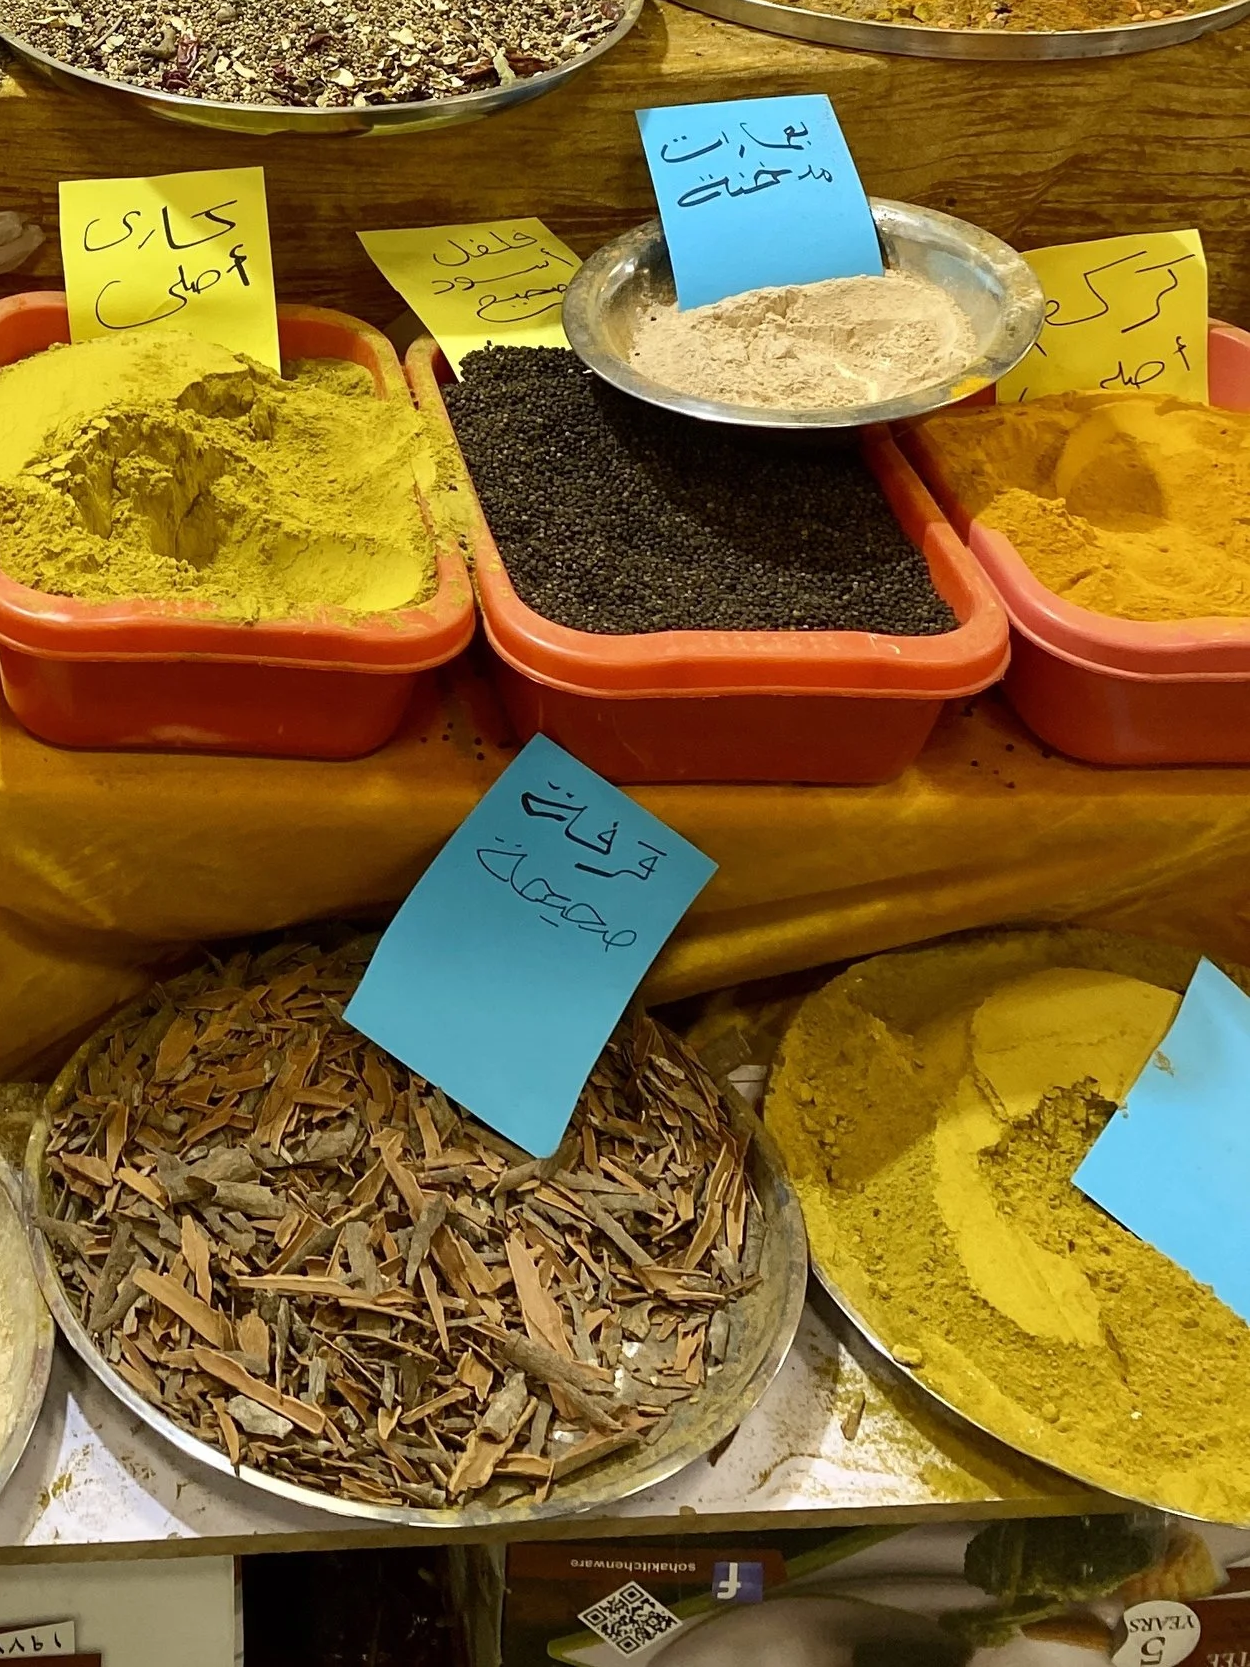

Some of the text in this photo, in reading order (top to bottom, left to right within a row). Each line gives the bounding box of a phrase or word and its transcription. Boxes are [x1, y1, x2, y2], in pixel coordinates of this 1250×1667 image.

[660, 121, 813, 164] بهارات
[433, 229, 538, 267] فلفل
[431, 246, 575, 295] أسود
[520, 780, 668, 881] قرفة
[570, 1558, 697, 1573] sohakitchenware
[1128, 1614, 1195, 1633] YEARS
